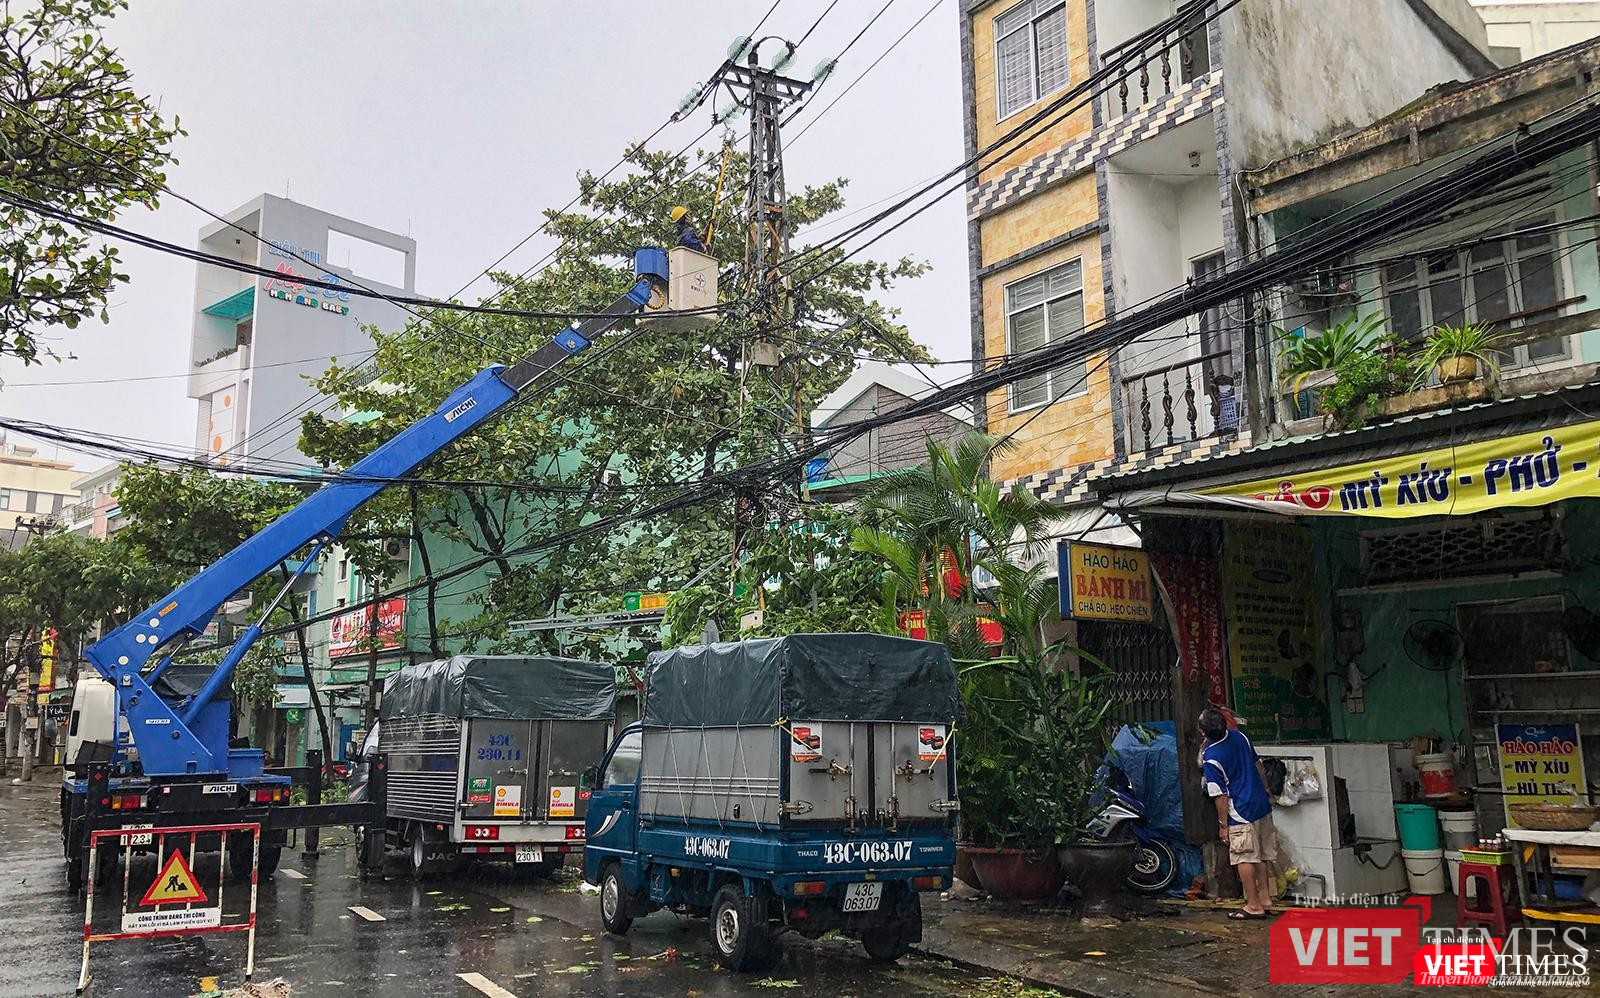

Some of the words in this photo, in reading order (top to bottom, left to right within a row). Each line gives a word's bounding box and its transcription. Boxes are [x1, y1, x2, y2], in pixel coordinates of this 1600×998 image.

[269, 290, 293, 302] MOM
[322, 302, 349, 315] BABY
[450, 399, 475, 420] AICHI
[1396, 462, 1452, 506] XÍU
[1484, 435, 1562, 496] PHỞ
[1503, 736, 1537, 755] HẢO
[1539, 736, 1574, 755] HẢO
[1543, 759, 1570, 774] XÍU
[209, 785, 236, 793] AICHI
[427, 852, 455, 861] JAC
[684, 836, 731, 860] 43C-063.07
[824, 841, 913, 864] 43C-063.07
[855, 884, 875, 896] 43C
[845, 896, 879, 910] 063.07
